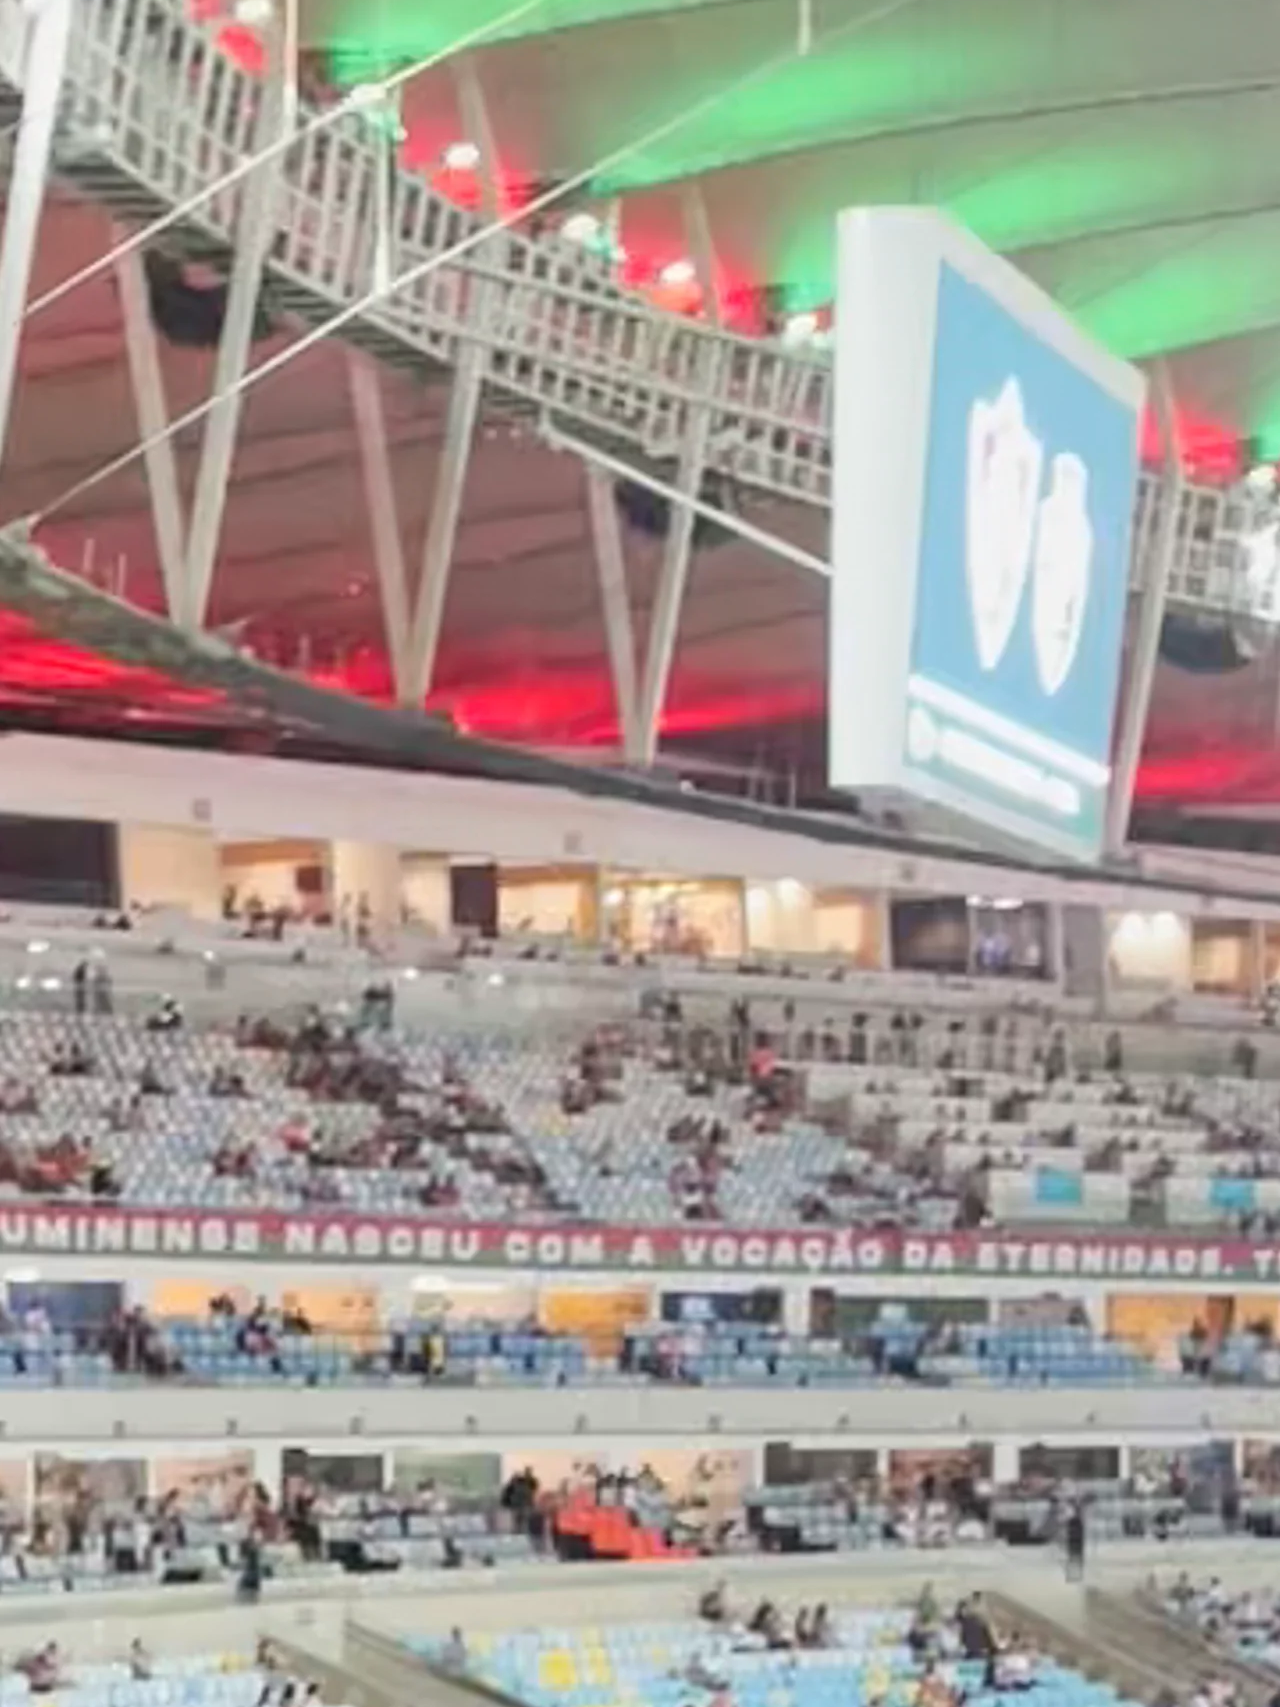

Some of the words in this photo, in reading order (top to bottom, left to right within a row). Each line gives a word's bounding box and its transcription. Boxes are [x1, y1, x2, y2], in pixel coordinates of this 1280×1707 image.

[285, 1220, 480, 1260] NASCEU
[505, 1231, 603, 1264] COM
[629, 1236, 654, 1265] A
[682, 1229, 885, 1273] VOCAÇÃO
[903, 1239, 955, 1269] DA
